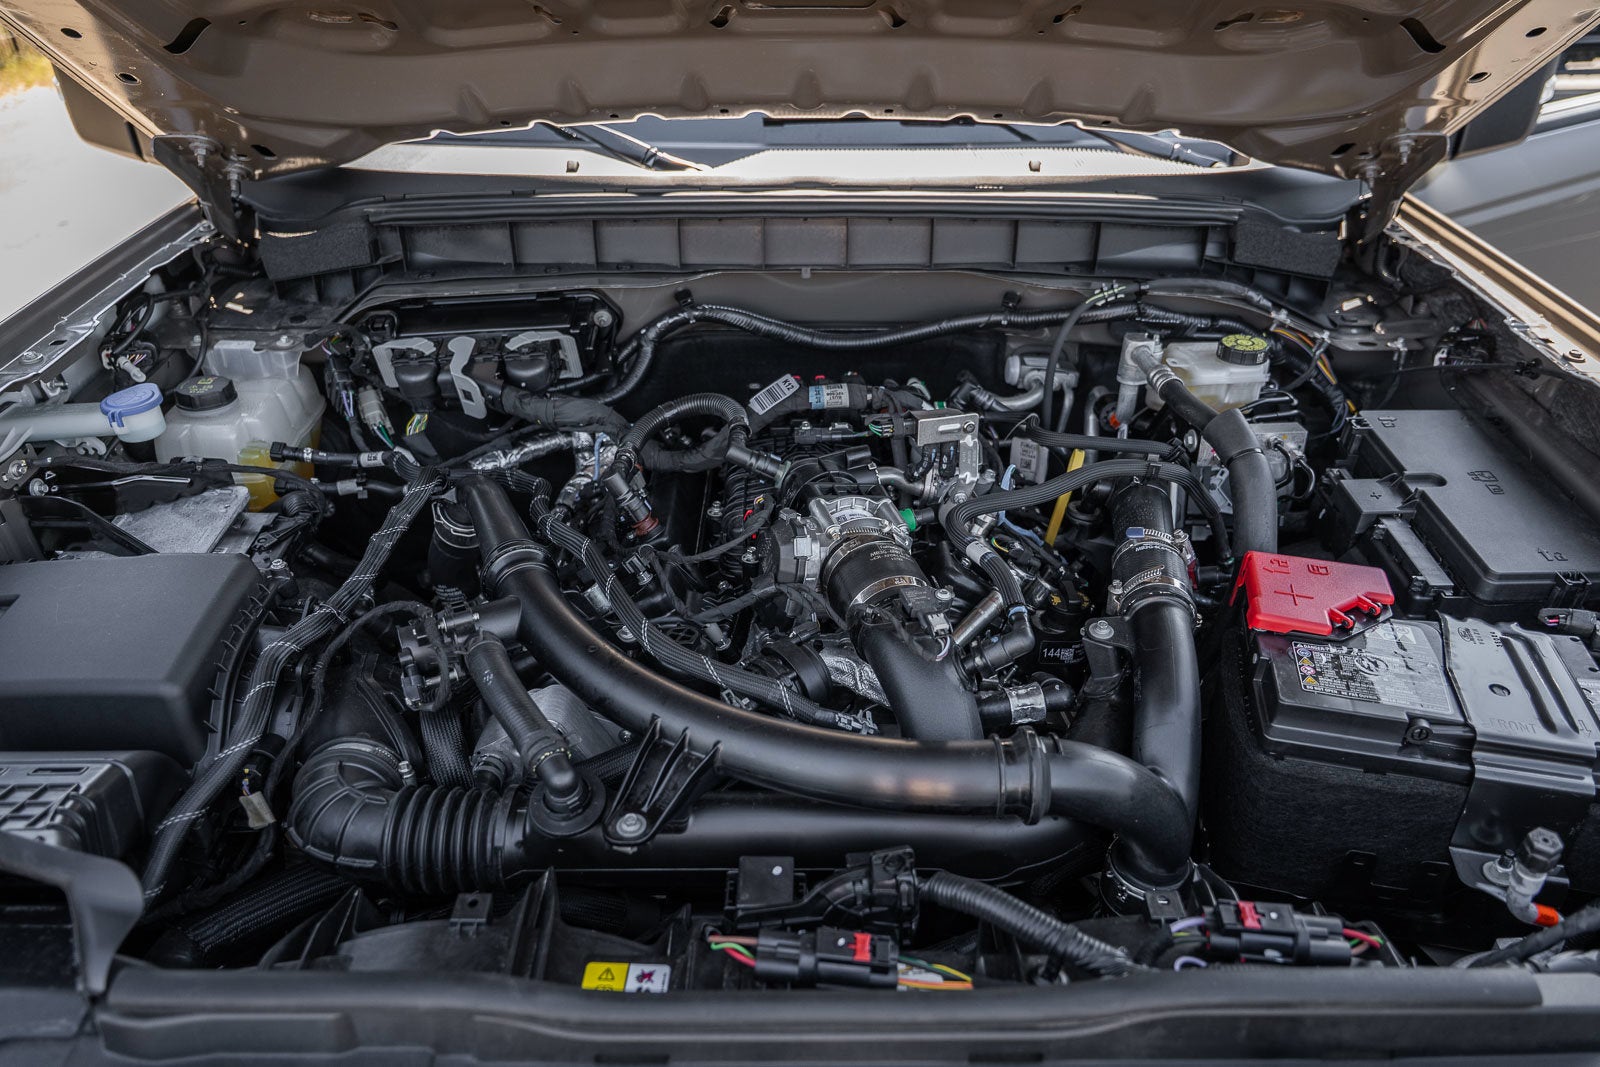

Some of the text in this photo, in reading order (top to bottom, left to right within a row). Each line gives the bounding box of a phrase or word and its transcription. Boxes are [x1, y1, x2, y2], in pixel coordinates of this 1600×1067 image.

[782, 378, 794, 391] K12
[1043, 648, 1060, 658] 144
[1488, 718, 1538, 734] FRONT
